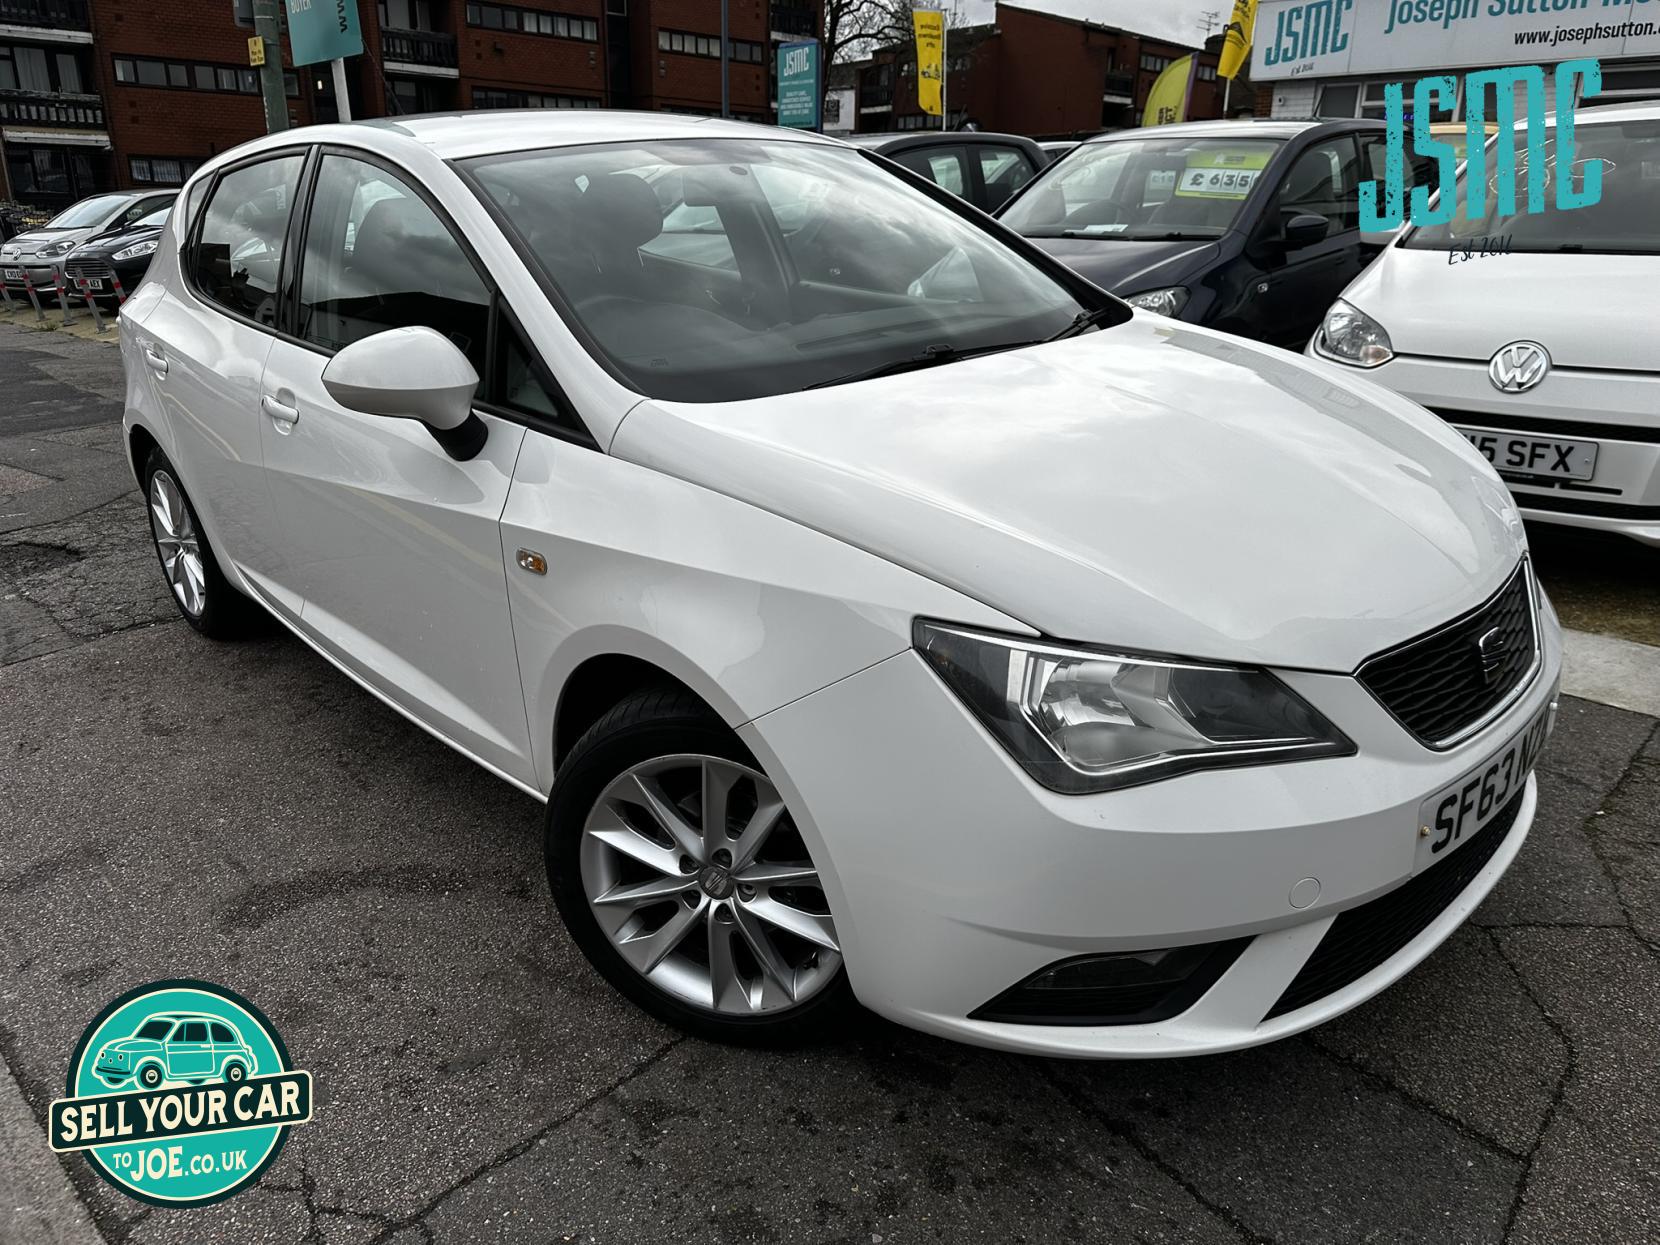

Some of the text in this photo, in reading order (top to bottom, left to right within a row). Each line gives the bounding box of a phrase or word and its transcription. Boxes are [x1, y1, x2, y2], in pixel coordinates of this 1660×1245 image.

[1264, 0, 1353, 66] JSMC
[783, 47, 810, 76] JSMC
[1506, 440, 1574, 472] SFX
[1431, 747, 1516, 854] SF63
